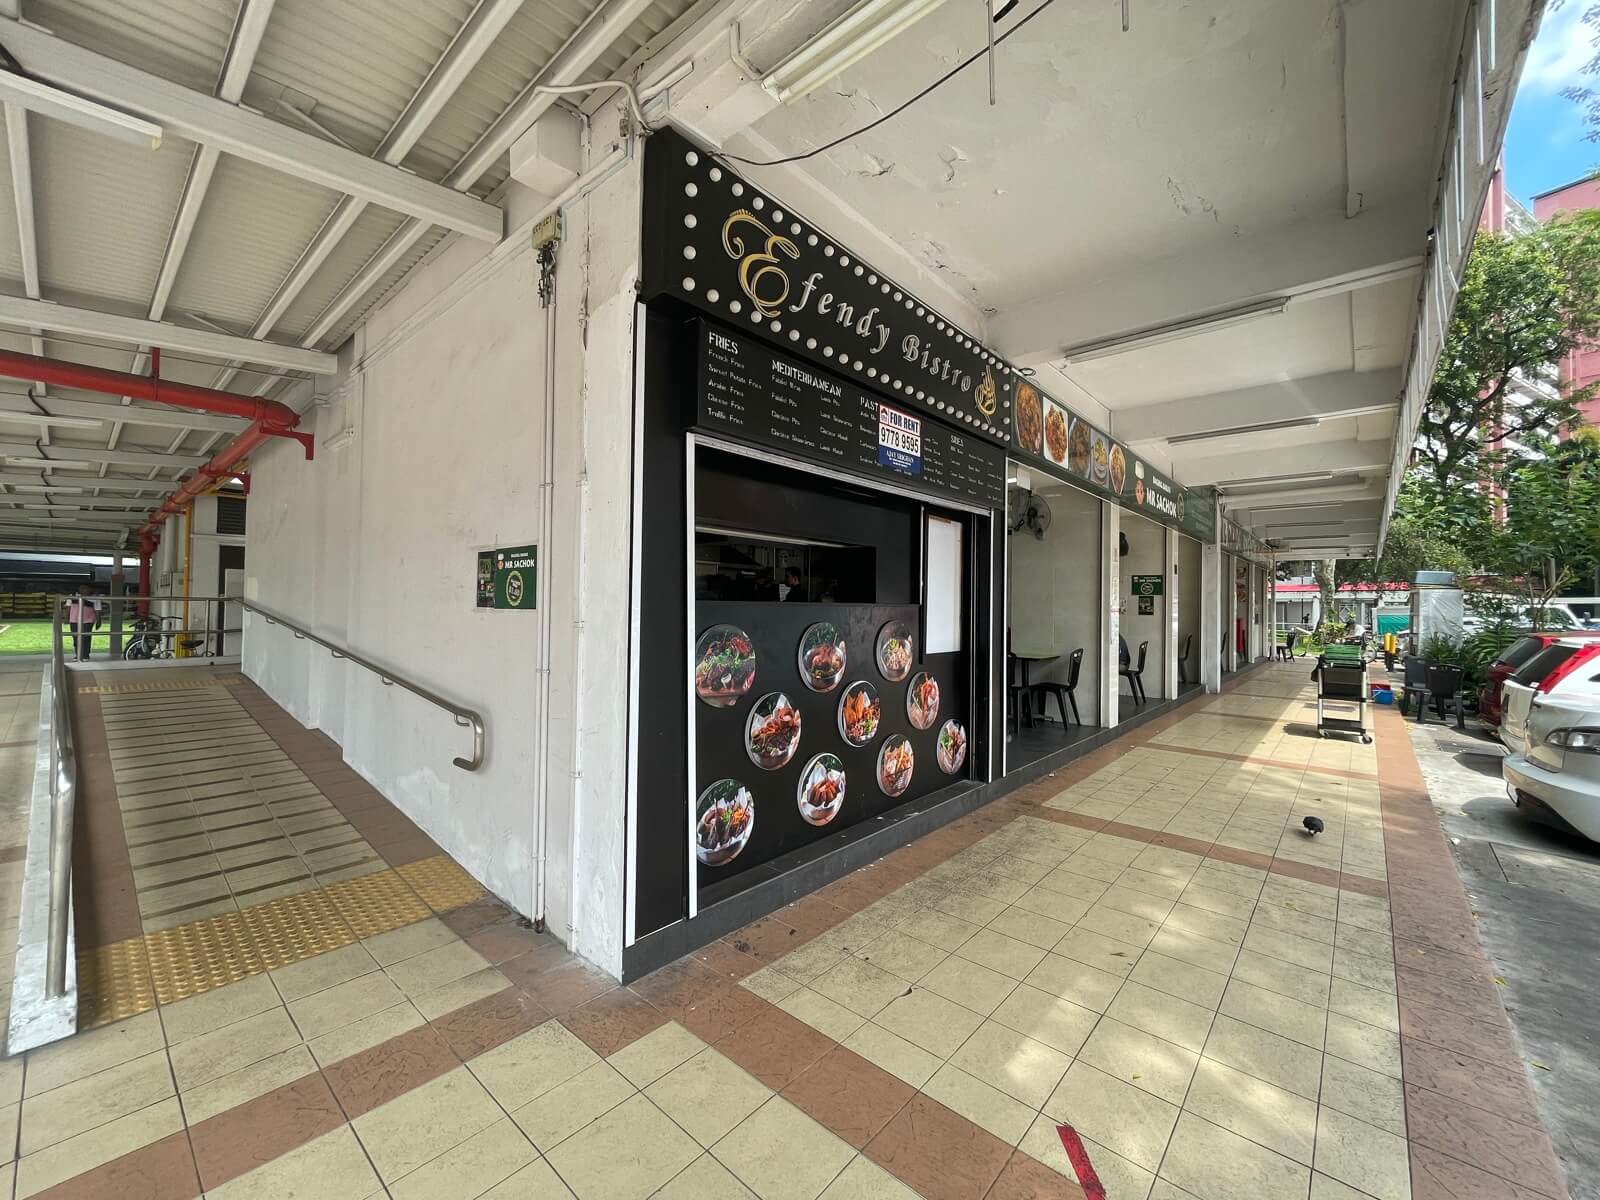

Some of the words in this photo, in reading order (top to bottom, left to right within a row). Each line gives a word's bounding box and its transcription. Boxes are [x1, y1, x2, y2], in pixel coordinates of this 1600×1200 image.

[722, 208, 890, 354] Efendy
[902, 334, 971, 392] Bistro
[708, 331, 738, 354] FRIES
[731, 358, 744, 368] Fries
[772, 360, 841, 397] MEDITERRANEAN
[861, 396, 878, 412] PAST
[890, 412, 902, 426] FOR
[904, 419, 918, 433] RENT
[881, 427, 899, 447] 9778
[902, 434, 918, 453] 9595
[1147, 488, 1155, 507] MR
[1156, 494, 1176, 518] SACHOK
[514, 559, 534, 568] SACHOK
